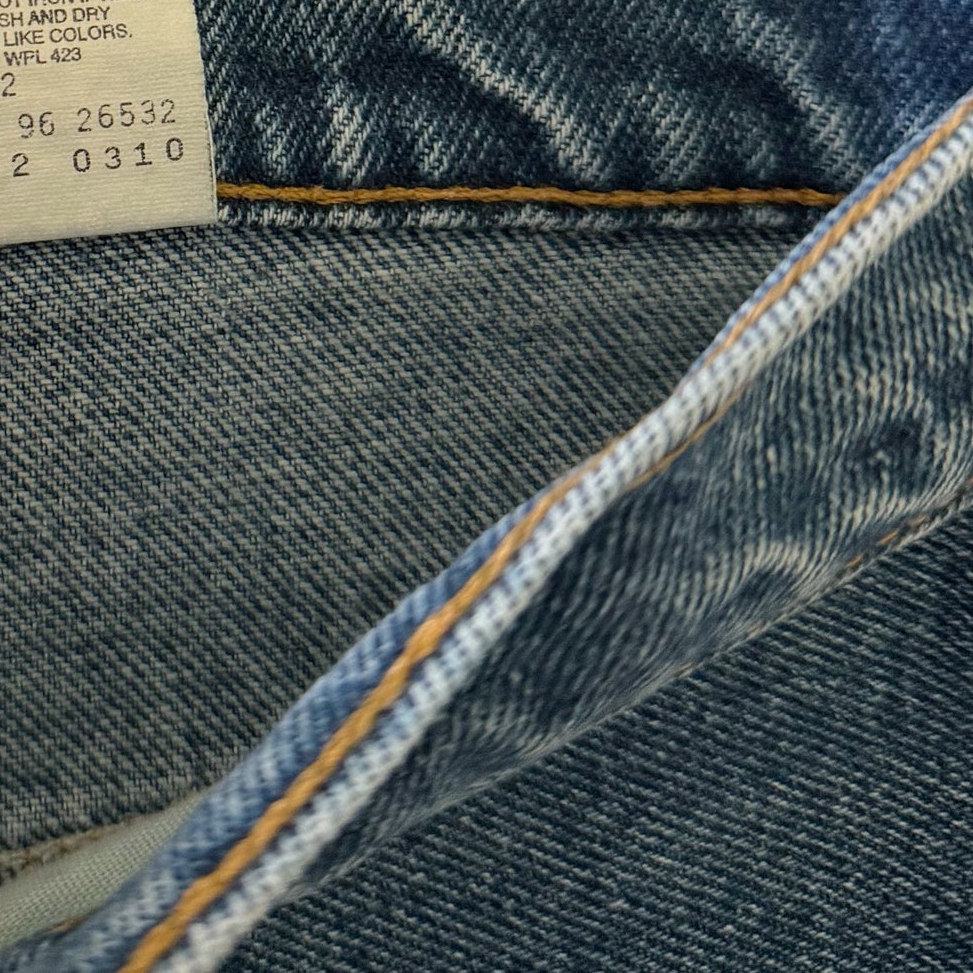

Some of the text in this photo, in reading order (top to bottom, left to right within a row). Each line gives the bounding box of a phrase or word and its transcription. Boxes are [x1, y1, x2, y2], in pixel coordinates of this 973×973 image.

[28, 10, 67, 24] AND
[73, 7, 110, 21] DRY
[4, 30, 43, 47] LIKE
[49, 24, 133, 42] COLORS.
[50, 47, 82, 63] 423
[18, 112, 55, 139] 96
[77, 99, 176, 132] 26532
[73, 137, 184, 172] 0310
